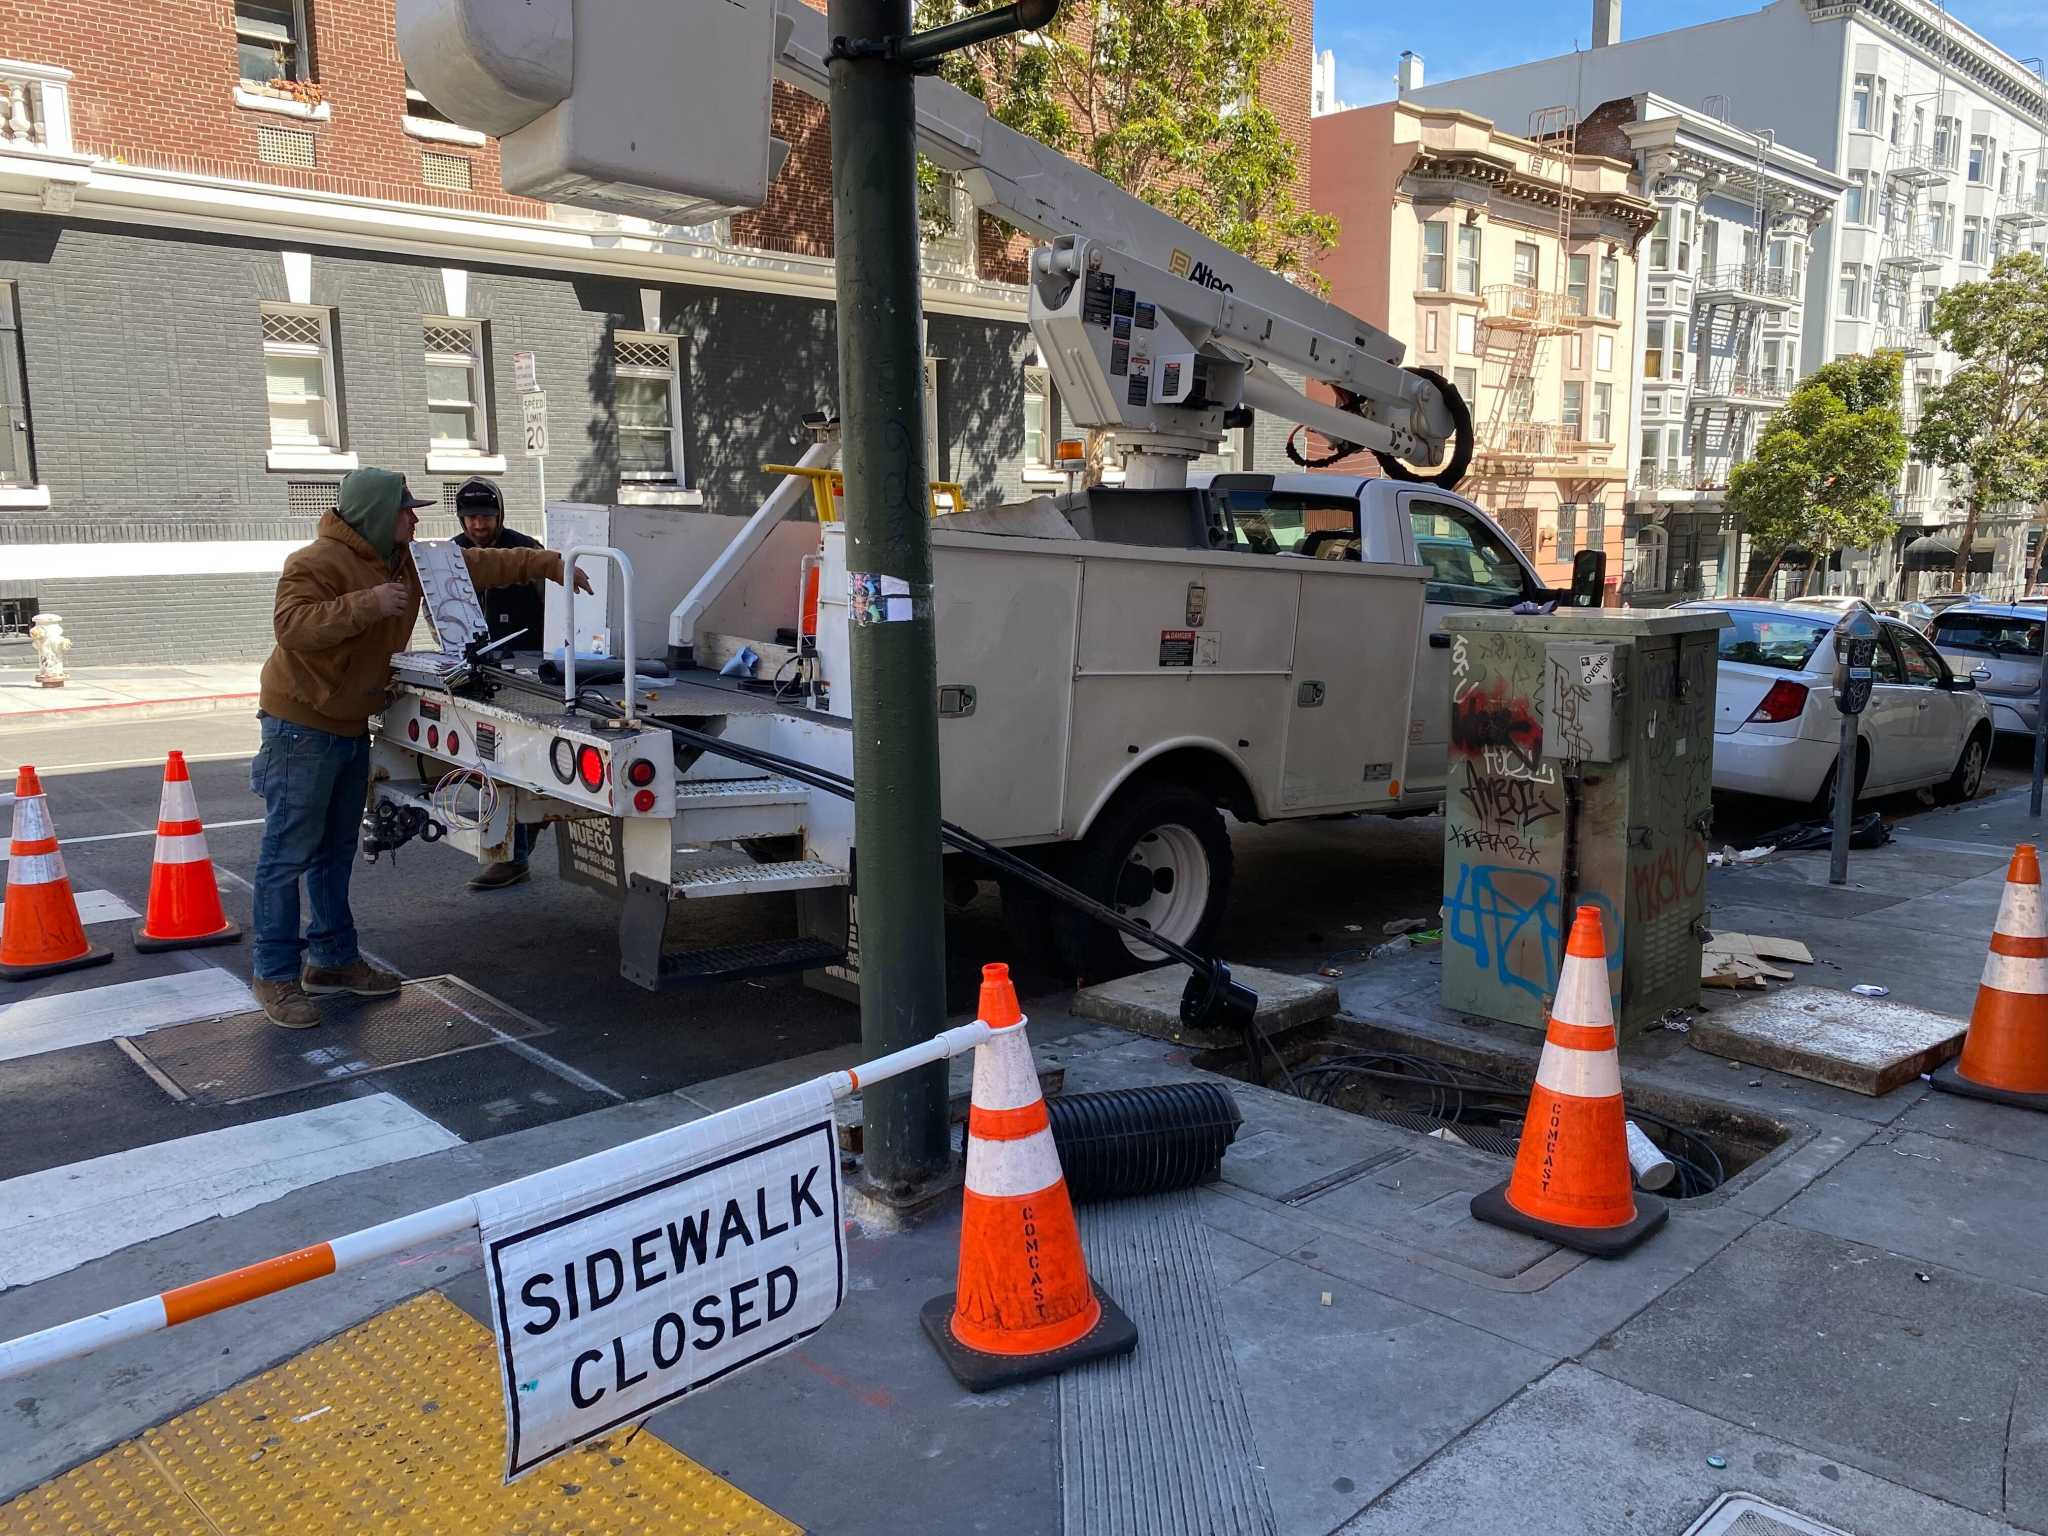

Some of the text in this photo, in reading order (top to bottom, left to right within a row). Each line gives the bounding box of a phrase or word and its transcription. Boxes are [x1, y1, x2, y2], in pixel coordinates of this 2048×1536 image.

[523, 399, 544, 410] SPEED
[526, 412, 543, 424] LIMIT
[526, 425, 545, 450] 20
[1584, 655, 1609, 684] OVENS
[1541, 1103, 1562, 1193] COMCAST
[521, 1165, 824, 1336] SIDEWALK
[1022, 1206, 1047, 1319] COMCAST
[570, 1265, 799, 1409] CLOSED
